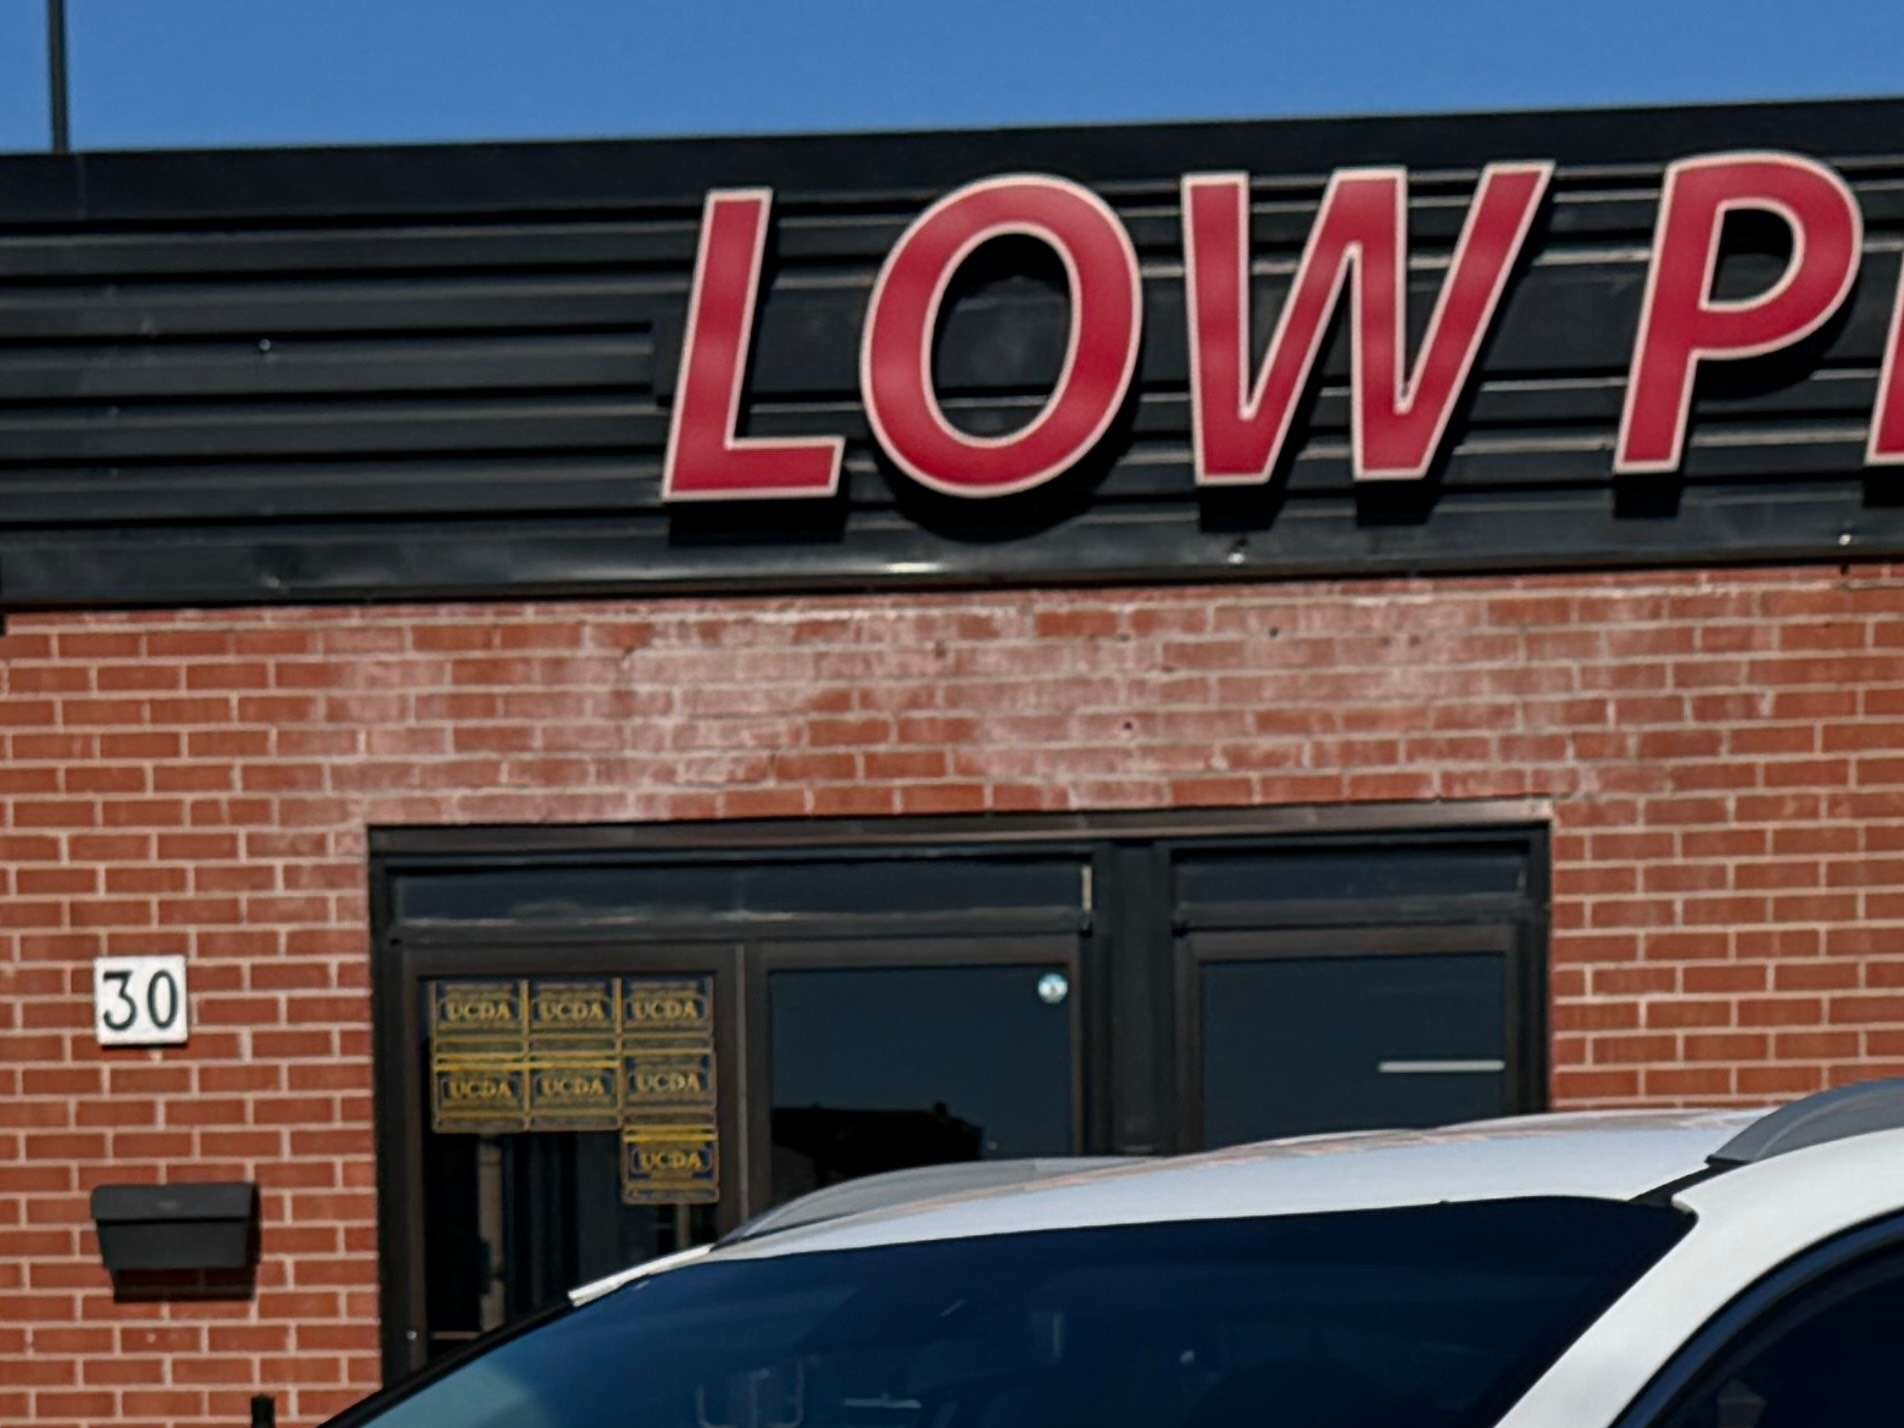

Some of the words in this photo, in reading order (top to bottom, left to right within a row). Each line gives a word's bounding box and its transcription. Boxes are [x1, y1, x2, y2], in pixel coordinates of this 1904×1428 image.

[663, 160, 1555, 501] LOW
[102, 969, 178, 1031] 30
[539, 1000, 604, 1020] UCDA
[633, 999, 698, 1019] UCDA
[447, 1001, 511, 1020] UCDA
[637, 1072, 701, 1091] UCDA
[640, 1150, 702, 1169] UCDA
